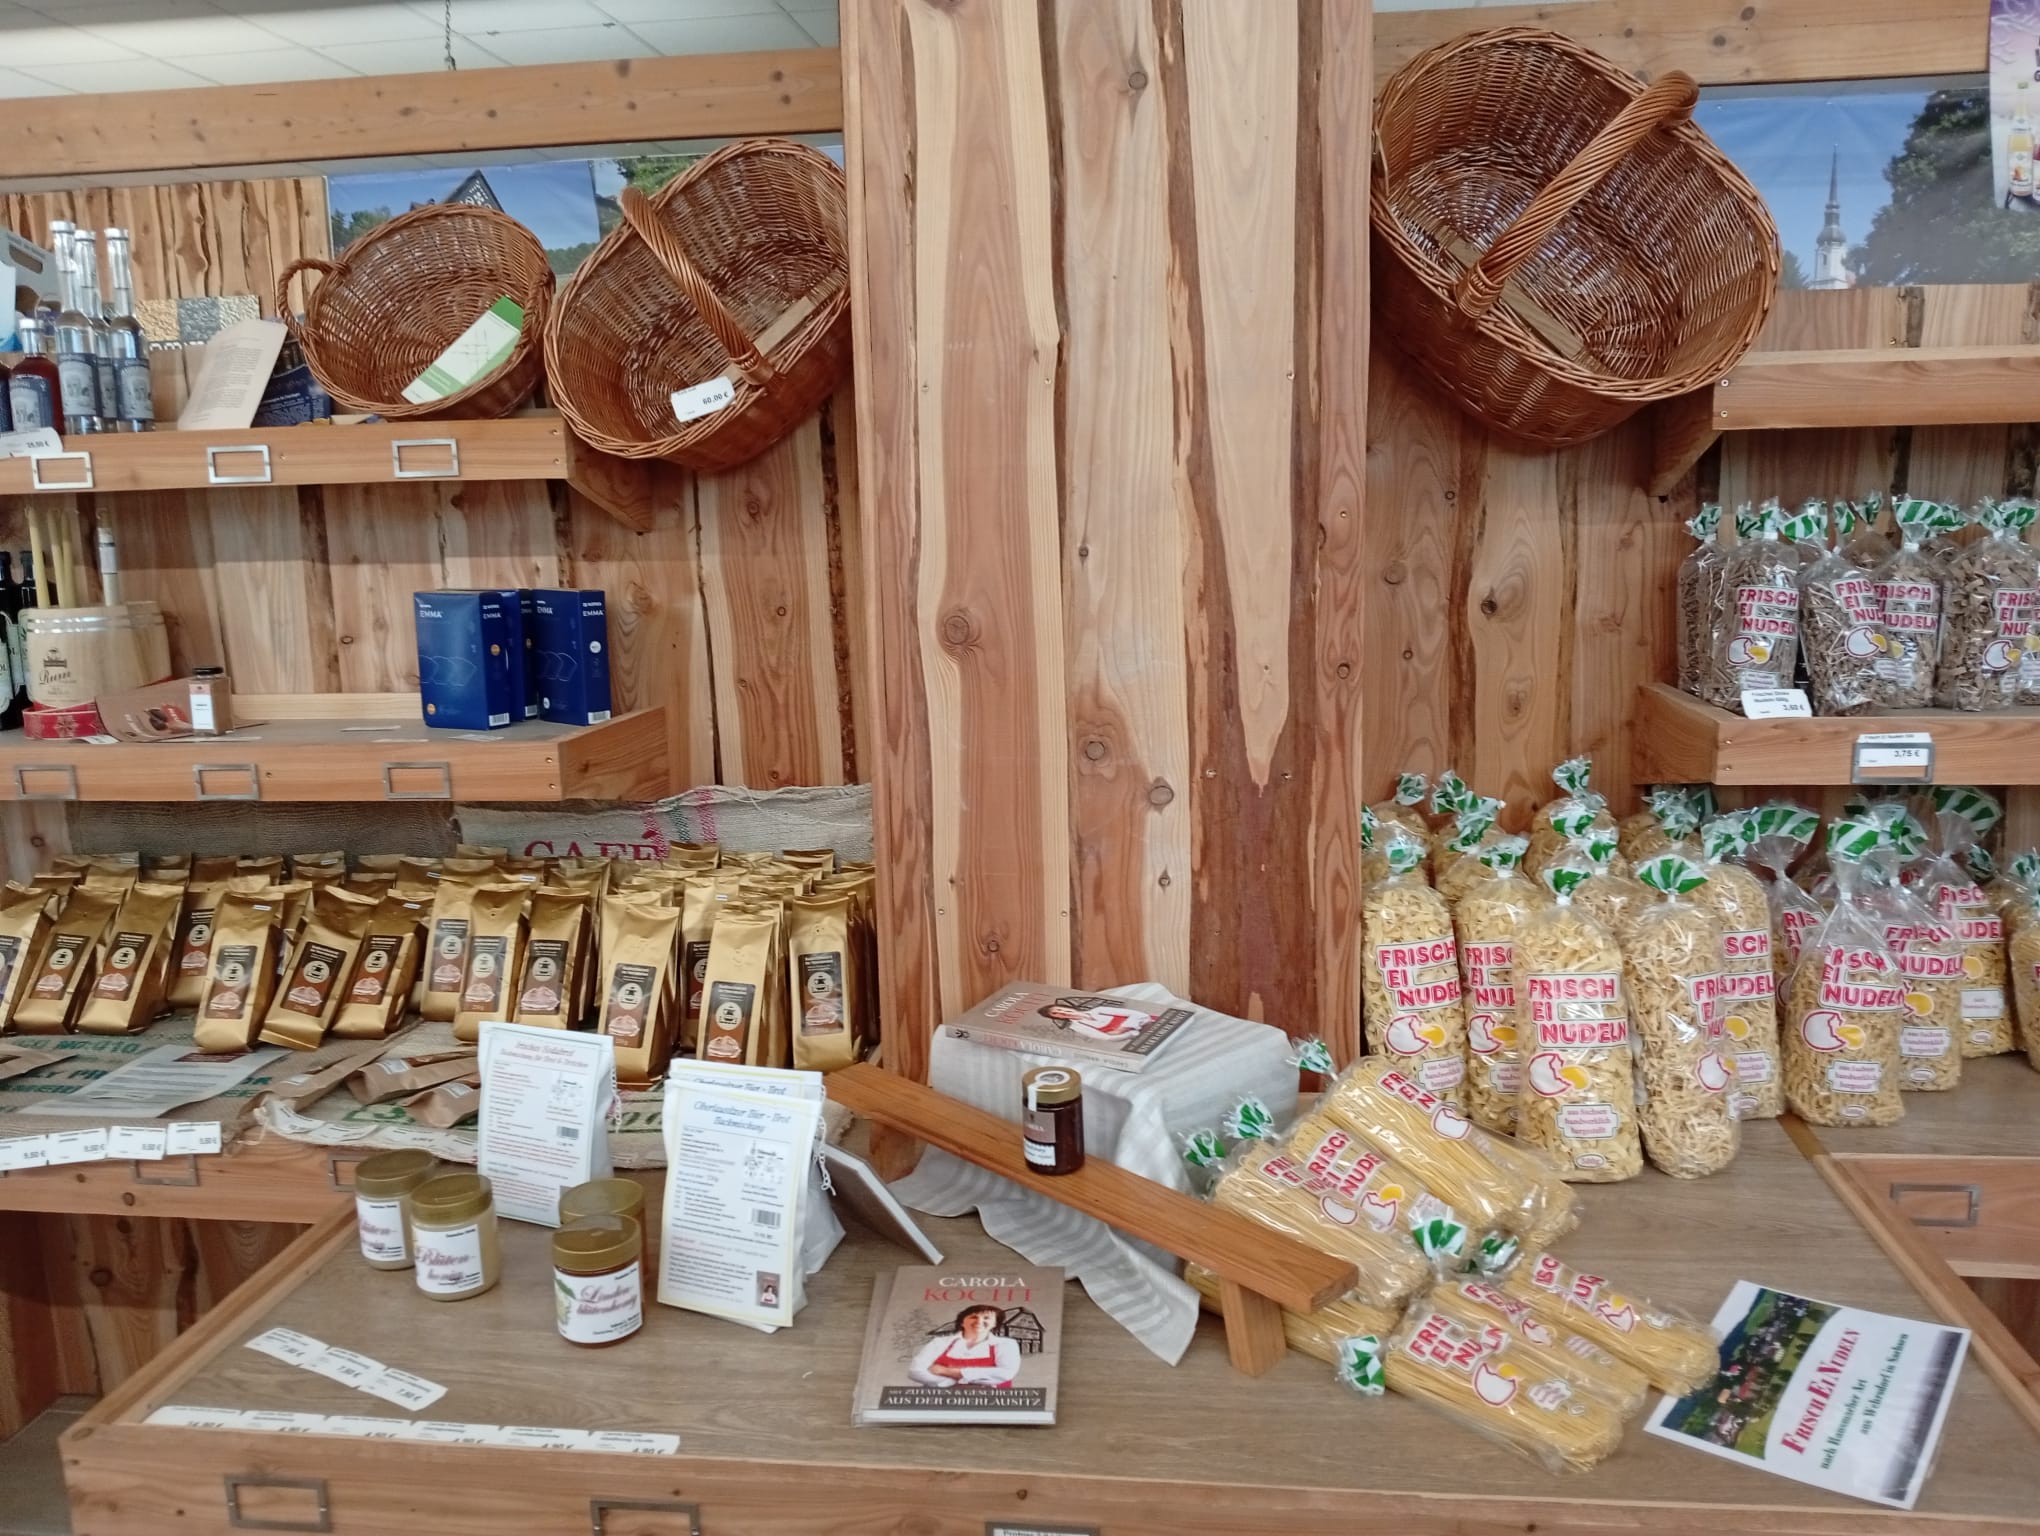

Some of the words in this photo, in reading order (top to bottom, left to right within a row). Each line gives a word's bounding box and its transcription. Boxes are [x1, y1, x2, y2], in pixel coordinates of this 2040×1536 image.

[1738, 588, 1798, 607] FRISCH
[1835, 581, 1872, 597] FRIS
[1844, 596, 1860, 609] EI
[1998, 592, 2032, 607] FRIS
[582, 609, 604, 617] EMMA
[2000, 607, 2014, 621] EI
[1379, 940, 1456, 968] FRISCH
[1726, 934, 1768, 956] SCH
[1387, 969, 1408, 988] EI
[1470, 967, 1484, 987] EI
[1397, 980, 1460, 1007] NUDEL
[1528, 978, 1615, 1000] FRISCH
[1532, 1001, 1553, 1022] EI
[1540, 1022, 1628, 1044] NUDELN
[1338, 1152, 1382, 1198] NUDE
[938, 1276, 1026, 1288] CAROLA
[923, 1288, 1039, 1302] KOCHT
[1430, 1339, 1455, 1364] EI
[883, 1396, 912, 1405] AUS
[914, 1396, 944, 1406] DER
[946, 1396, 1043, 1407] OBERLAUSITZ
[1819, 1447, 1838, 1471] nach
[1850, 1377, 1868, 1393] Art
